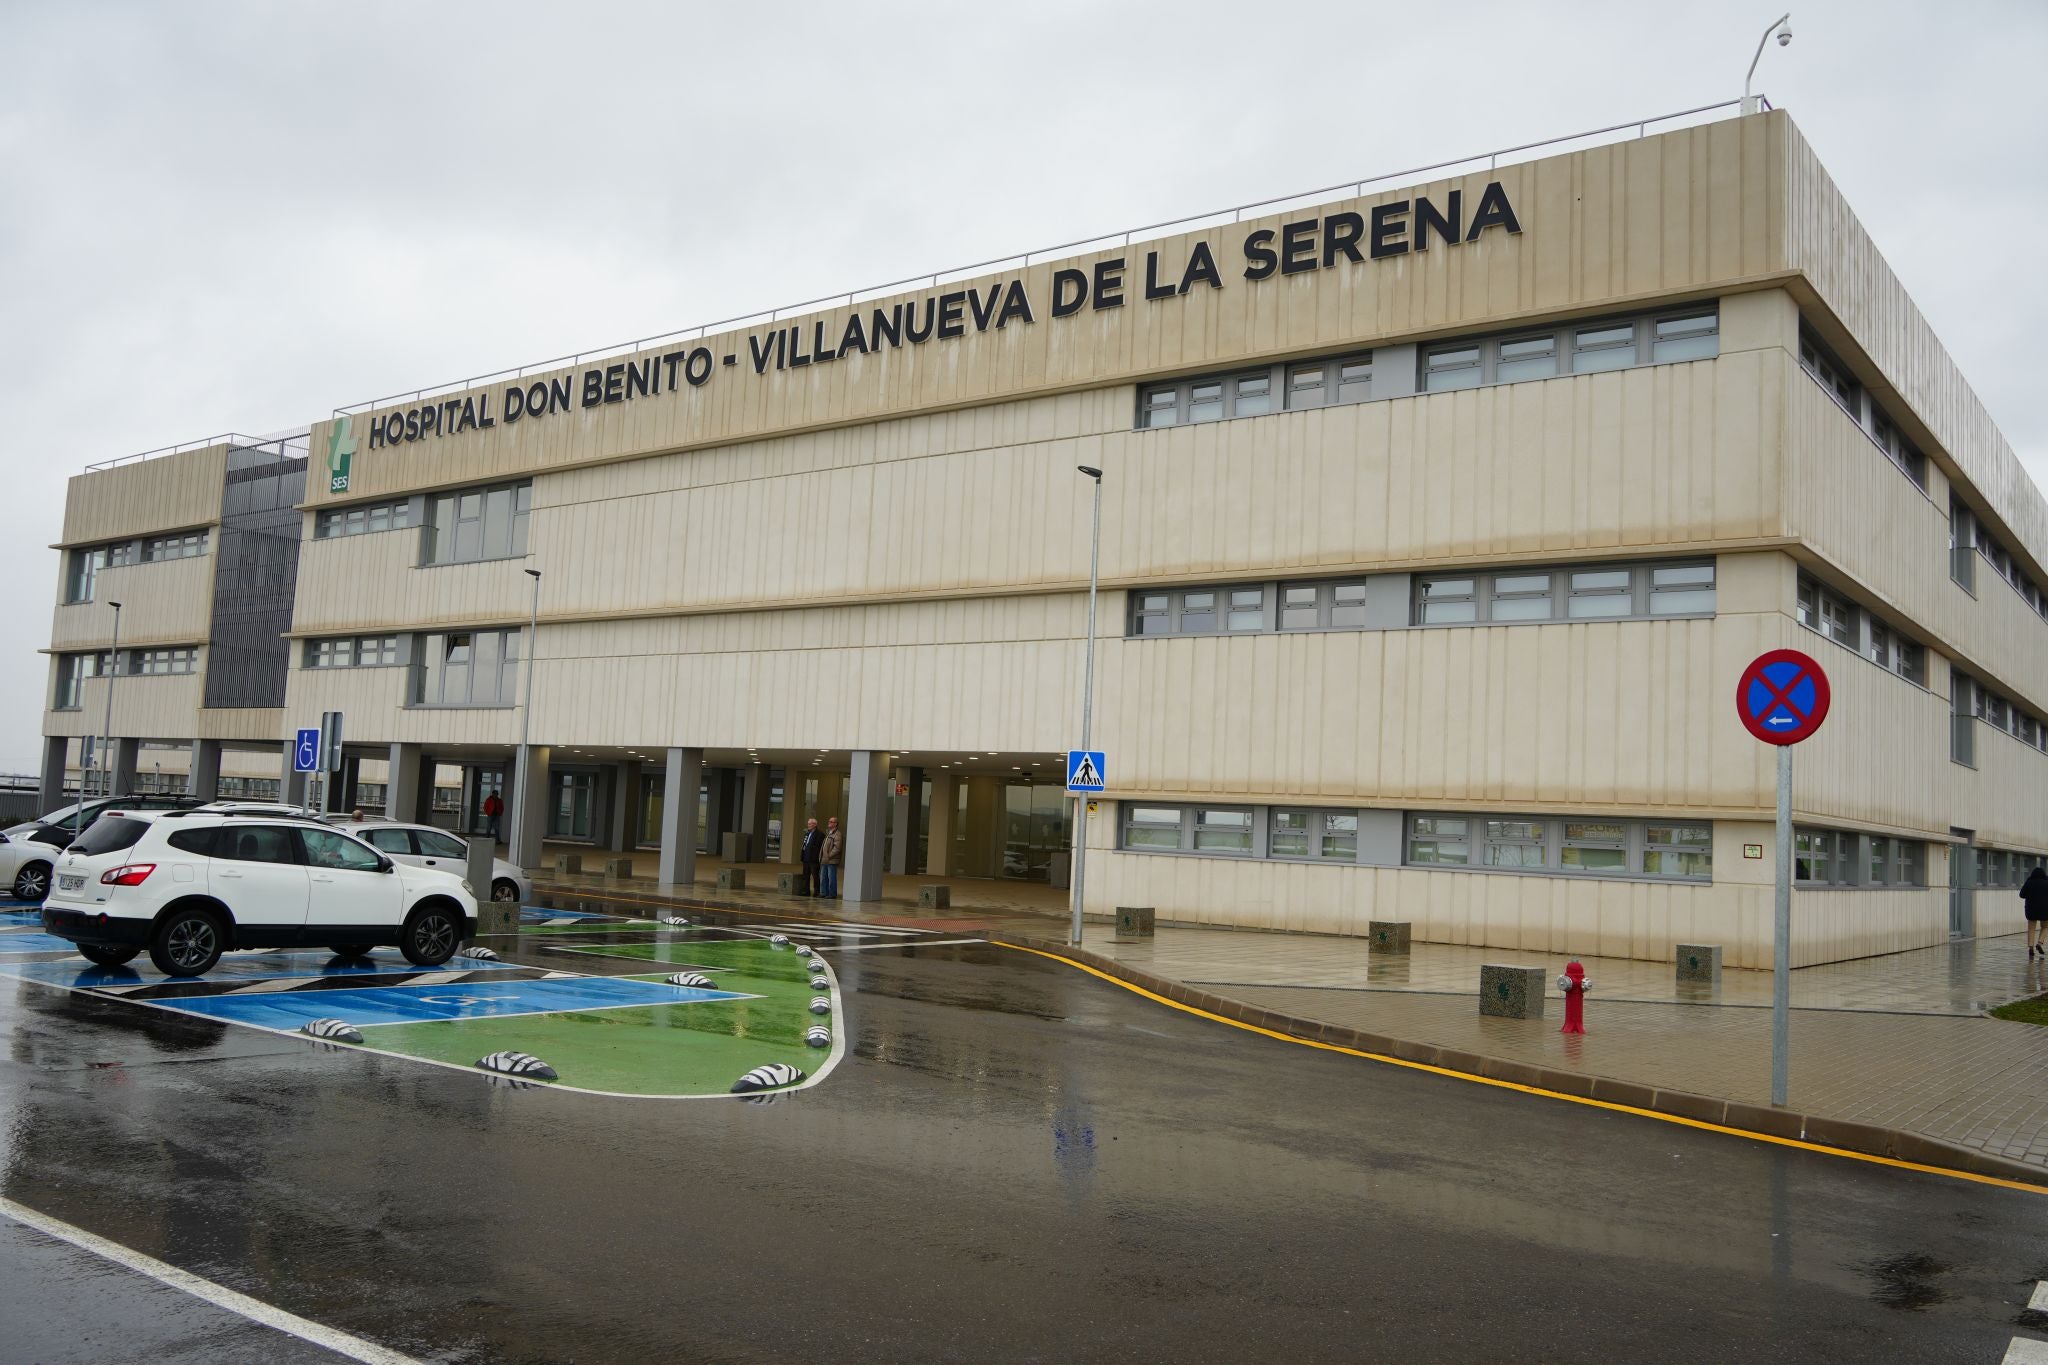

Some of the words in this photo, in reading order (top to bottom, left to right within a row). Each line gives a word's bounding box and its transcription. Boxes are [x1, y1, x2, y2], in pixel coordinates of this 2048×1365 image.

[369, 393, 495, 449] HOSPITAL
[503, 375, 572, 423] DON
[581, 347, 713, 408] BENITO
[748, 279, 1034, 374] VILLANUEVA
[1051, 257, 1126, 319] DE
[1145, 241, 1223, 302] LA
[1243, 181, 1523, 281] SERENA
[332, 476, 348, 490] SES
